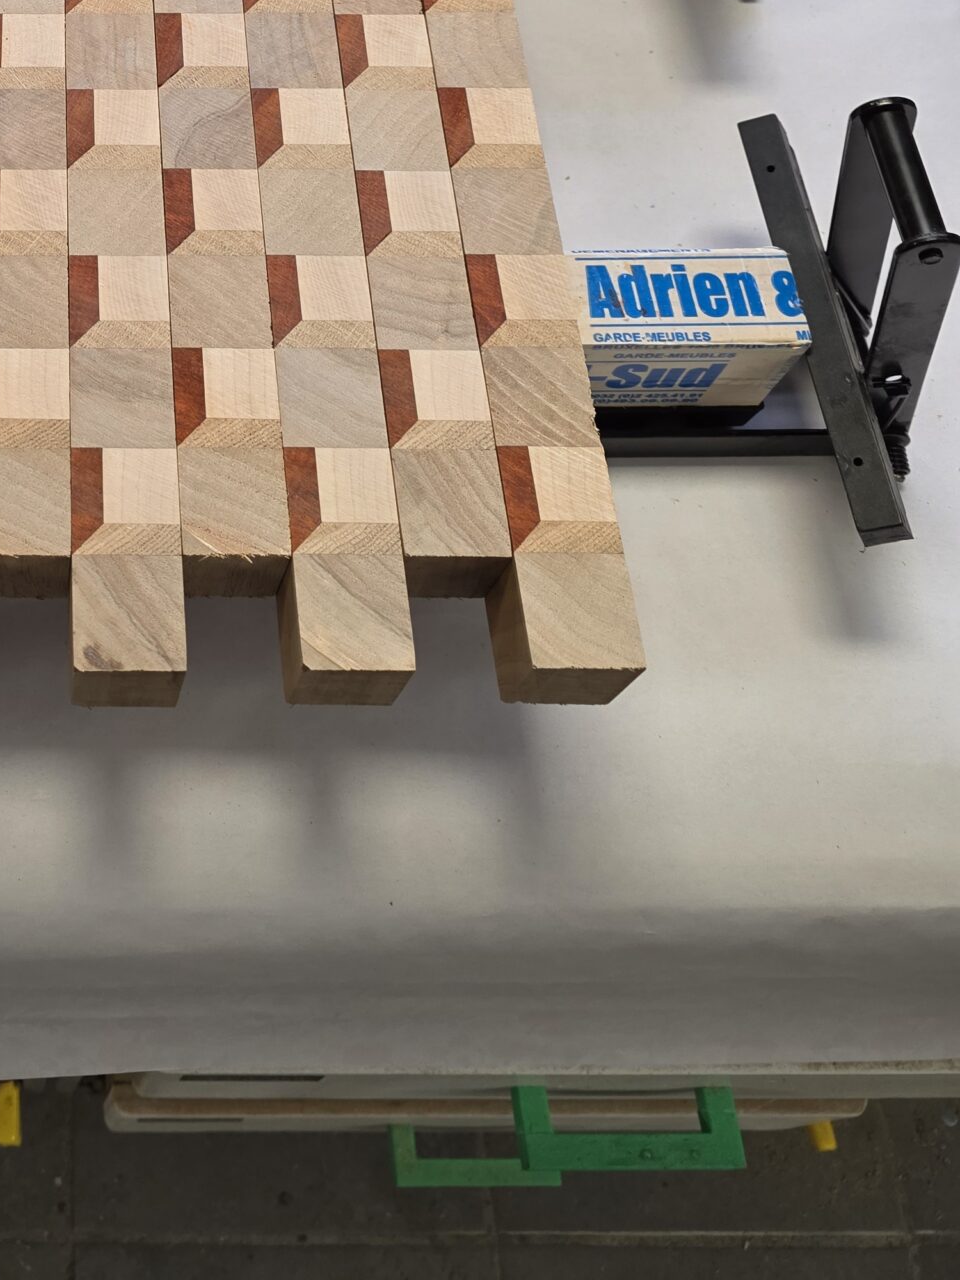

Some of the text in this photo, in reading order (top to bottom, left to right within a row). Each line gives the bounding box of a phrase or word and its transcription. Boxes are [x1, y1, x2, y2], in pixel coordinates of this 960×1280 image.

[585, 264, 766, 319] Adrien
[593, 331, 712, 343] GARDE-MEUBLES
[587, 363, 728, 389] -Sud
